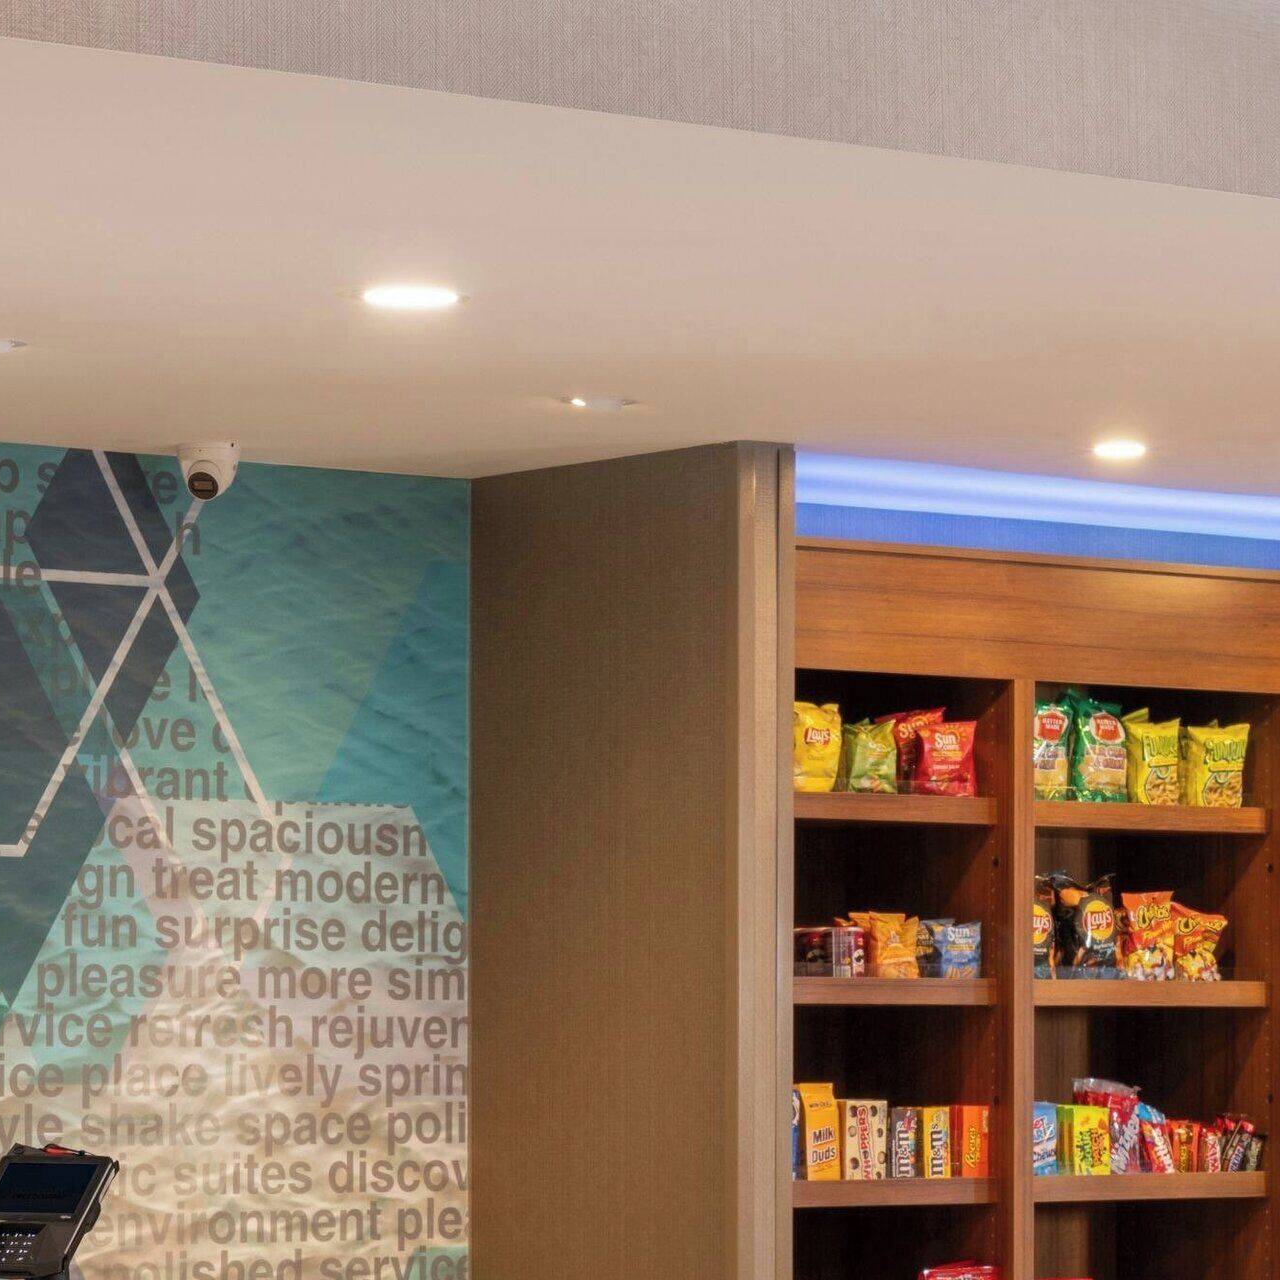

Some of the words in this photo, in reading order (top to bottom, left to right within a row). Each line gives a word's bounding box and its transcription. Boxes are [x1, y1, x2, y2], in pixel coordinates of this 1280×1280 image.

[152, 857, 259, 902] treat
[275, 862, 445, 905] modern
[61, 903, 138, 950] fun
[154, 907, 347, 961] surprise
[1086, 910, 1112, 931] Lay's
[36, 954, 242, 1015] pleasure
[258, 964, 373, 1002] more
[129, 1004, 294, 1049] refresh
[81, 1053, 209, 1109] place
[224, 1053, 343, 1109] lively
[80, 1102, 221, 1148] shake
[236, 1110, 372, 1157] space
[812, 1128, 835, 1145] Milk
[173, 1151, 313, 1196] suites
[811, 1147, 836, 1165] Duds
[86, 1201, 382, 1248] environment
